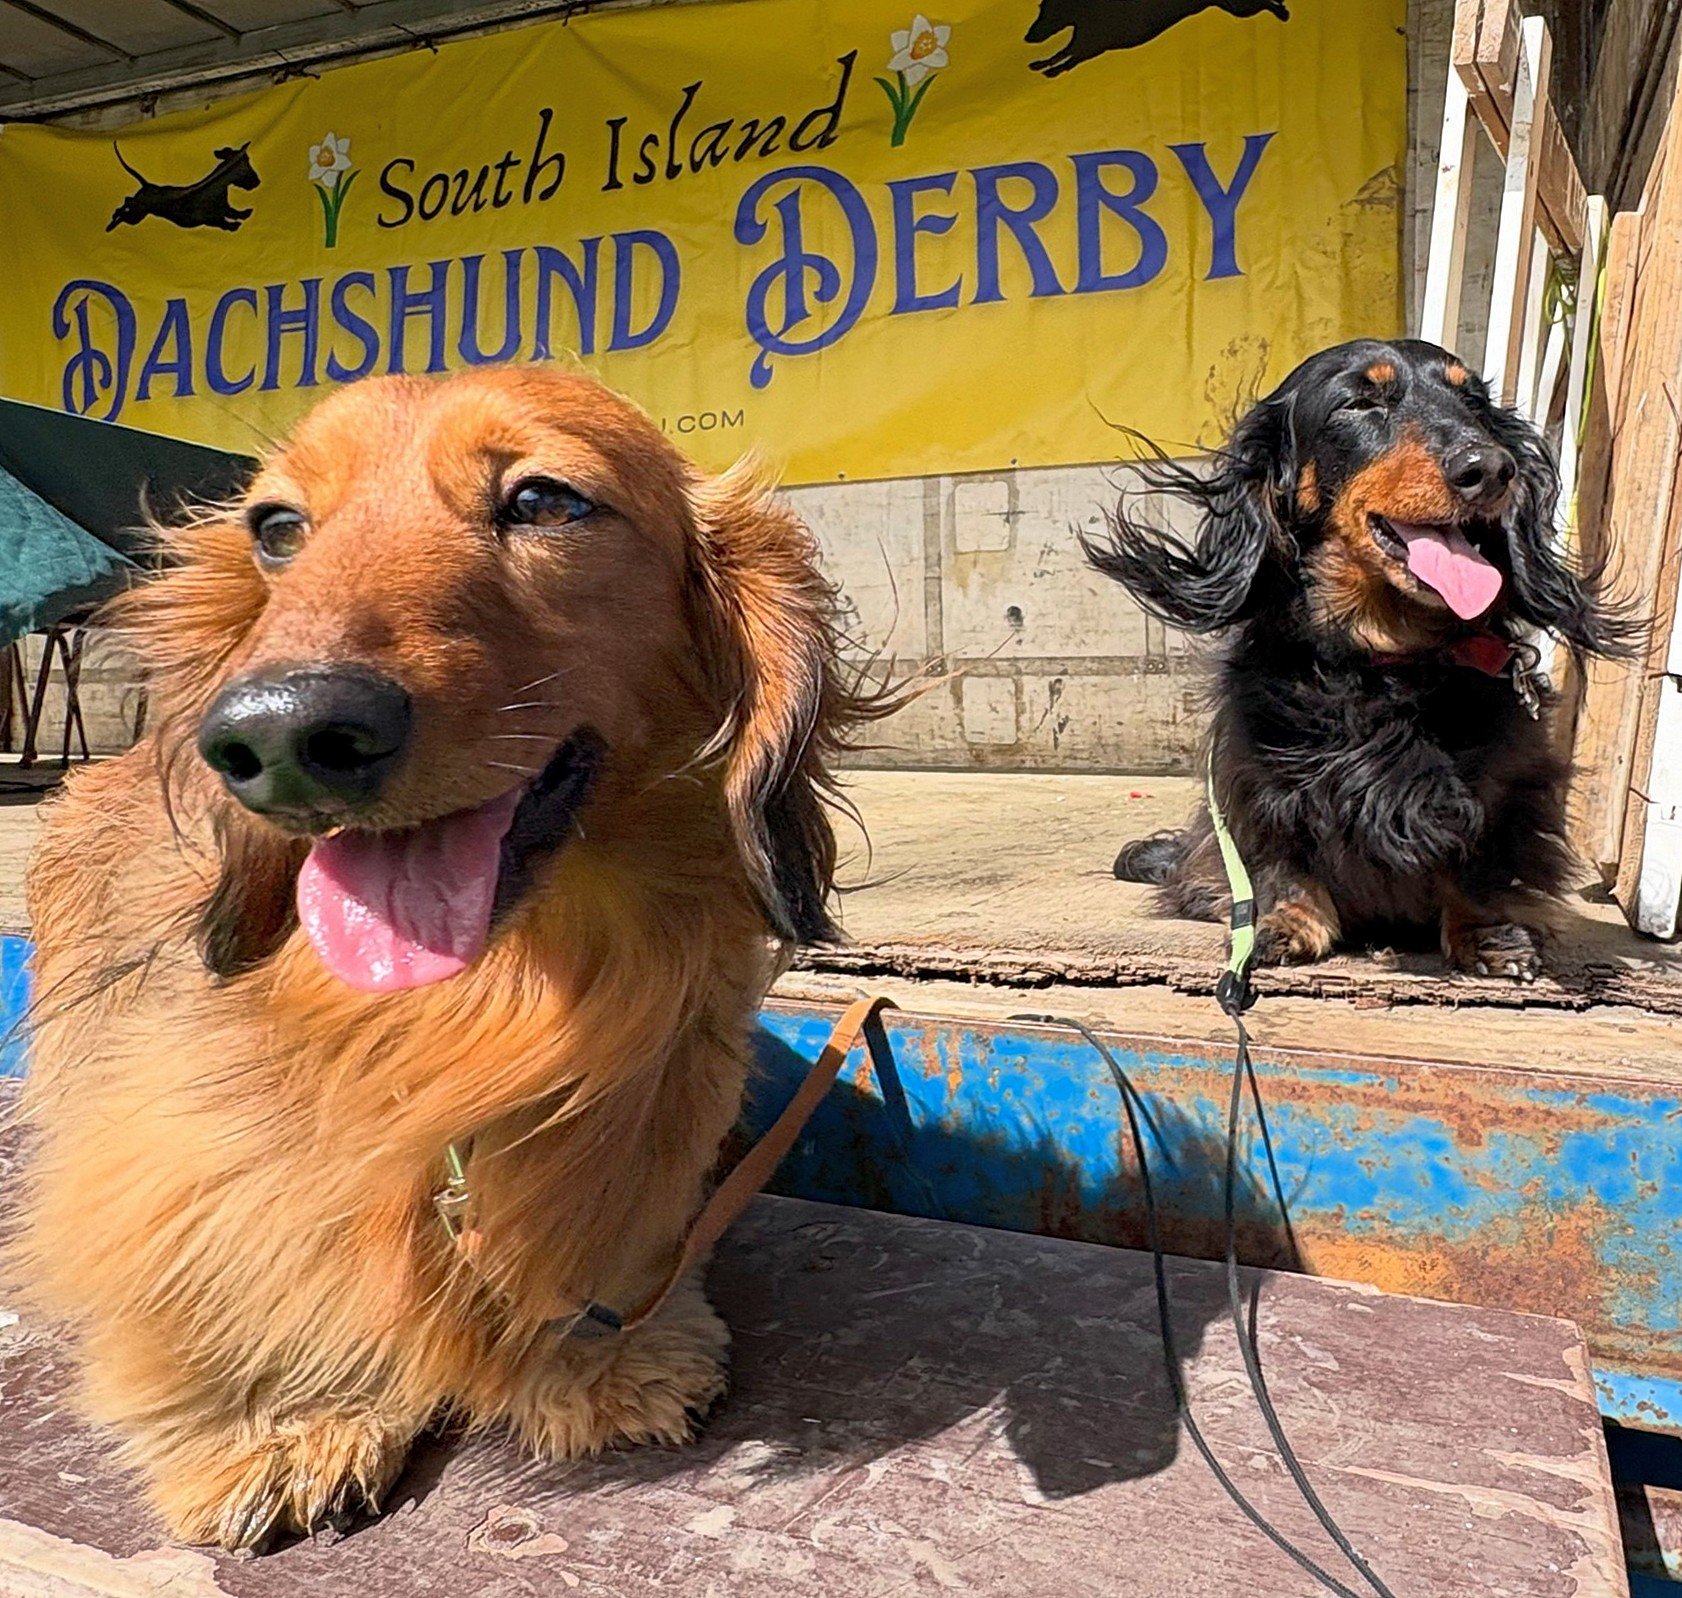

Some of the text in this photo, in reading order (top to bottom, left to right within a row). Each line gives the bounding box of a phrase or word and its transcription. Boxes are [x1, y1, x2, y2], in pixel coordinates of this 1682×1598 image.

[376, 49, 858, 228] South Island
[53, 131, 1277, 423] DACHSHUND DERBY
[661, 408, 745, 435] .COM
